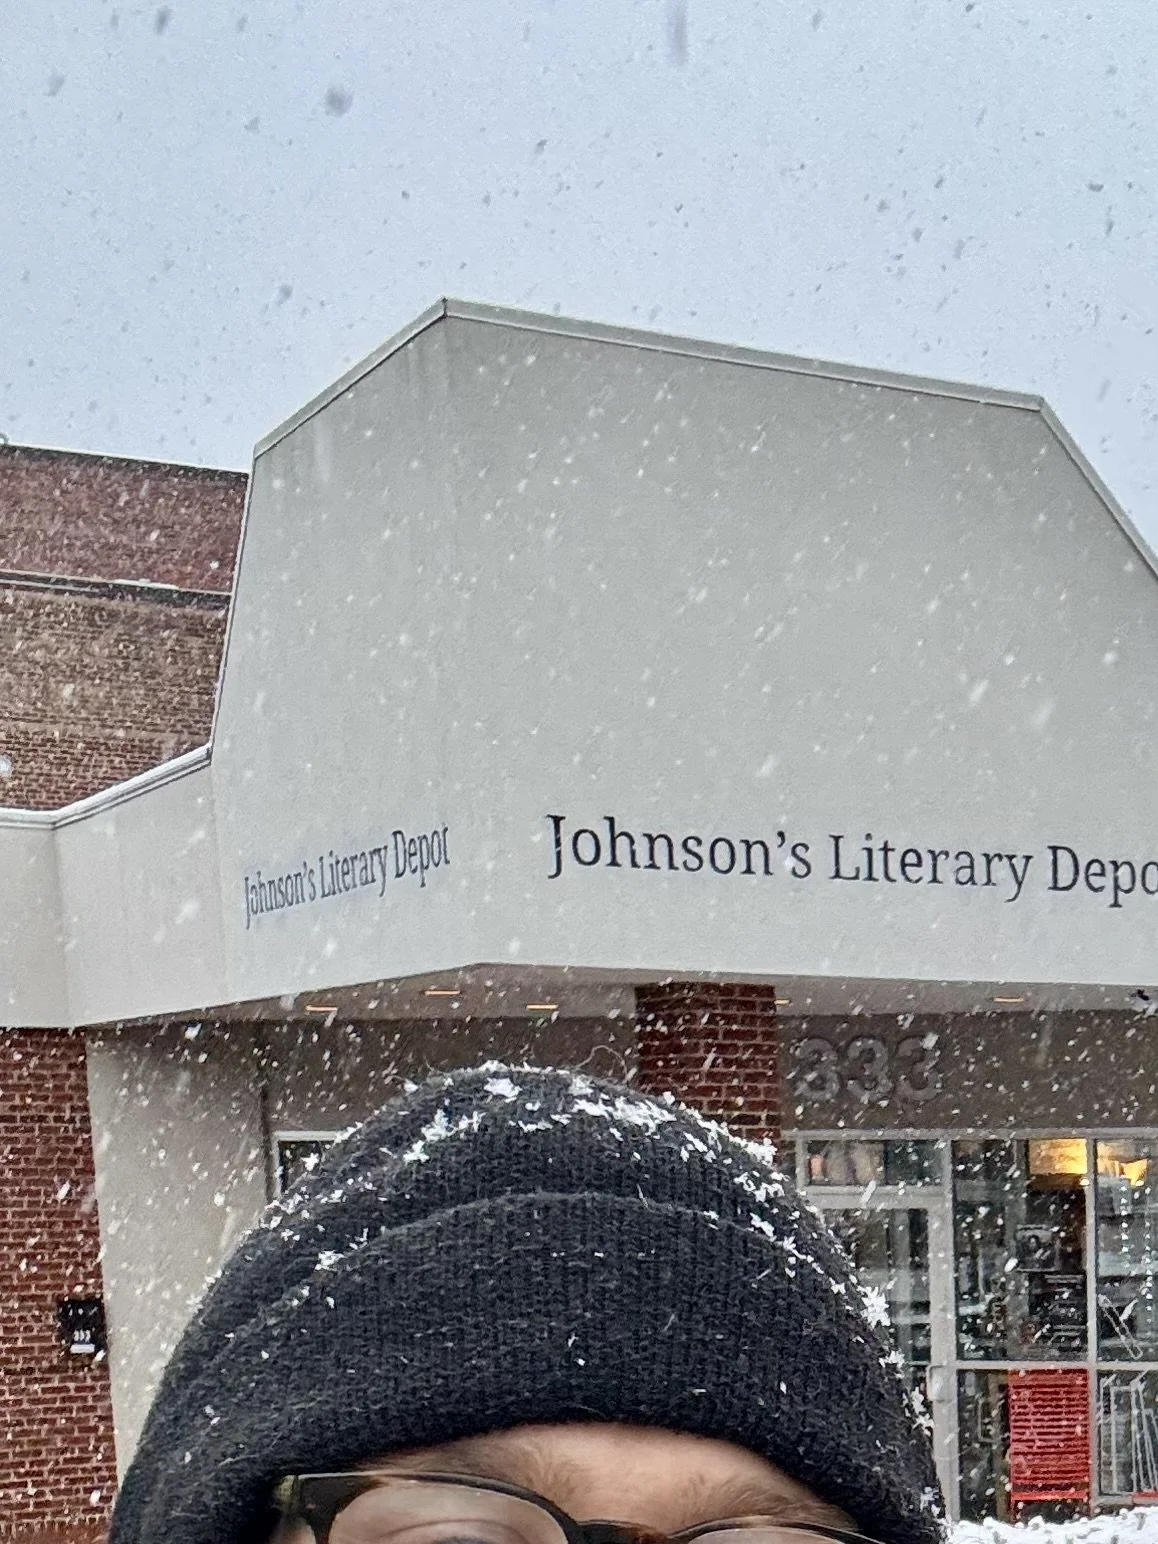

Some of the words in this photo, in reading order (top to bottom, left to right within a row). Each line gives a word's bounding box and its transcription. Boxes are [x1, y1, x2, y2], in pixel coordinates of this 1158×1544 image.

[244, 861, 317, 930] Johnson’s
[319, 845, 389, 898] Literary
[391, 824, 451, 888] Depot
[546, 813, 812, 880] Johnson’s
[828, 833, 1034, 903] Literary
[797, 1036, 942, 1101] 333
